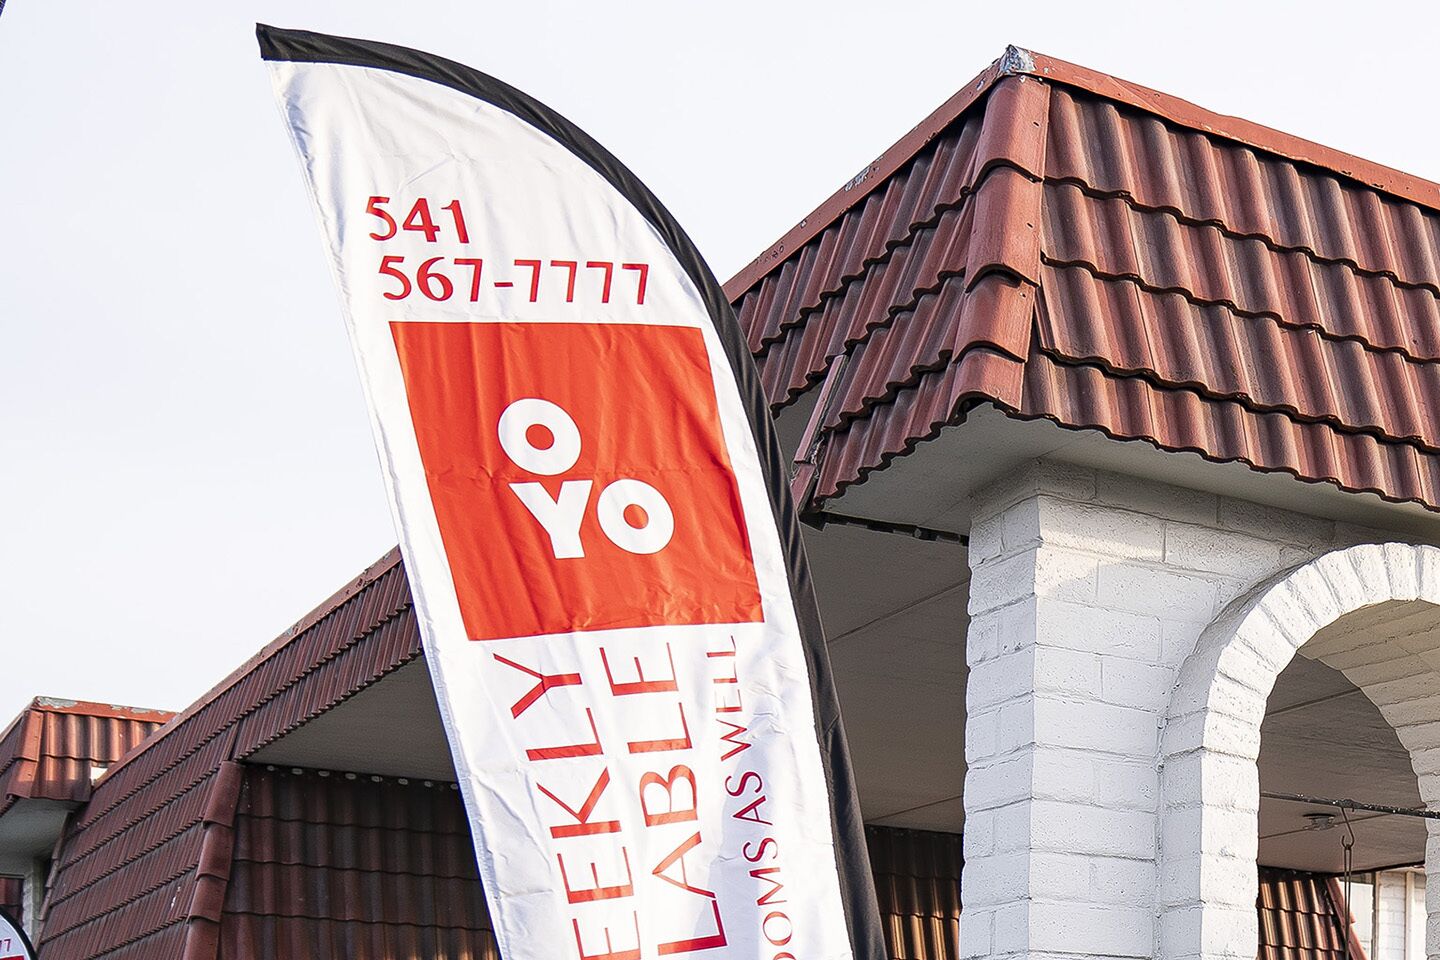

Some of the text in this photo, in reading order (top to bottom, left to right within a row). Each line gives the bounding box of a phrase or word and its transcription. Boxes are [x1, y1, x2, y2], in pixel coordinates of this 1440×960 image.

[366, 196, 469, 244] 541
[379, 256, 649, 304] 567-7777
[706, 635, 751, 761] WELL
[725, 772, 772, 825] AS
